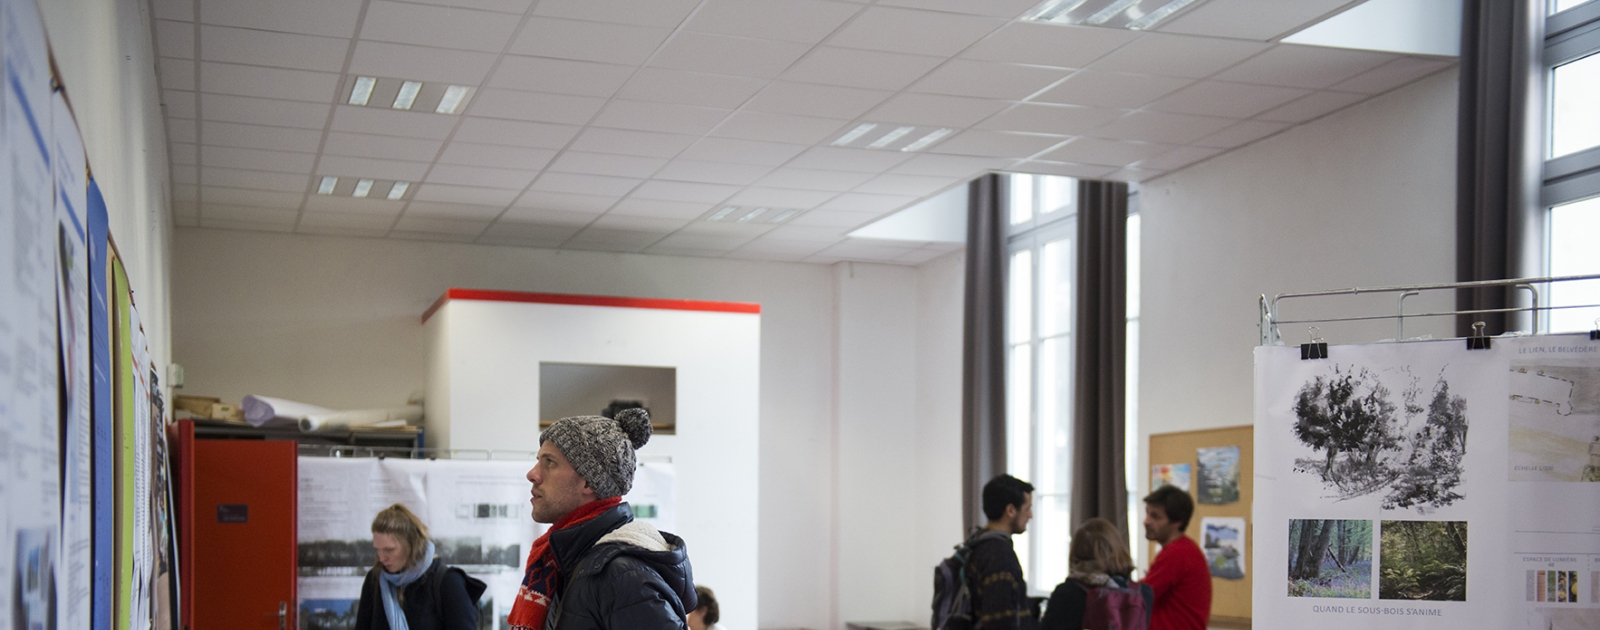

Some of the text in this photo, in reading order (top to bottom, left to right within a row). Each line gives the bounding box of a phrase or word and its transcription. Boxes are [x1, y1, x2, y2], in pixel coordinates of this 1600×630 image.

[1312, 605, 1344, 614] QUAND
[1346, 606, 1355, 614] LE
[1357, 606, 1404, 615] SOUS-BOIS
